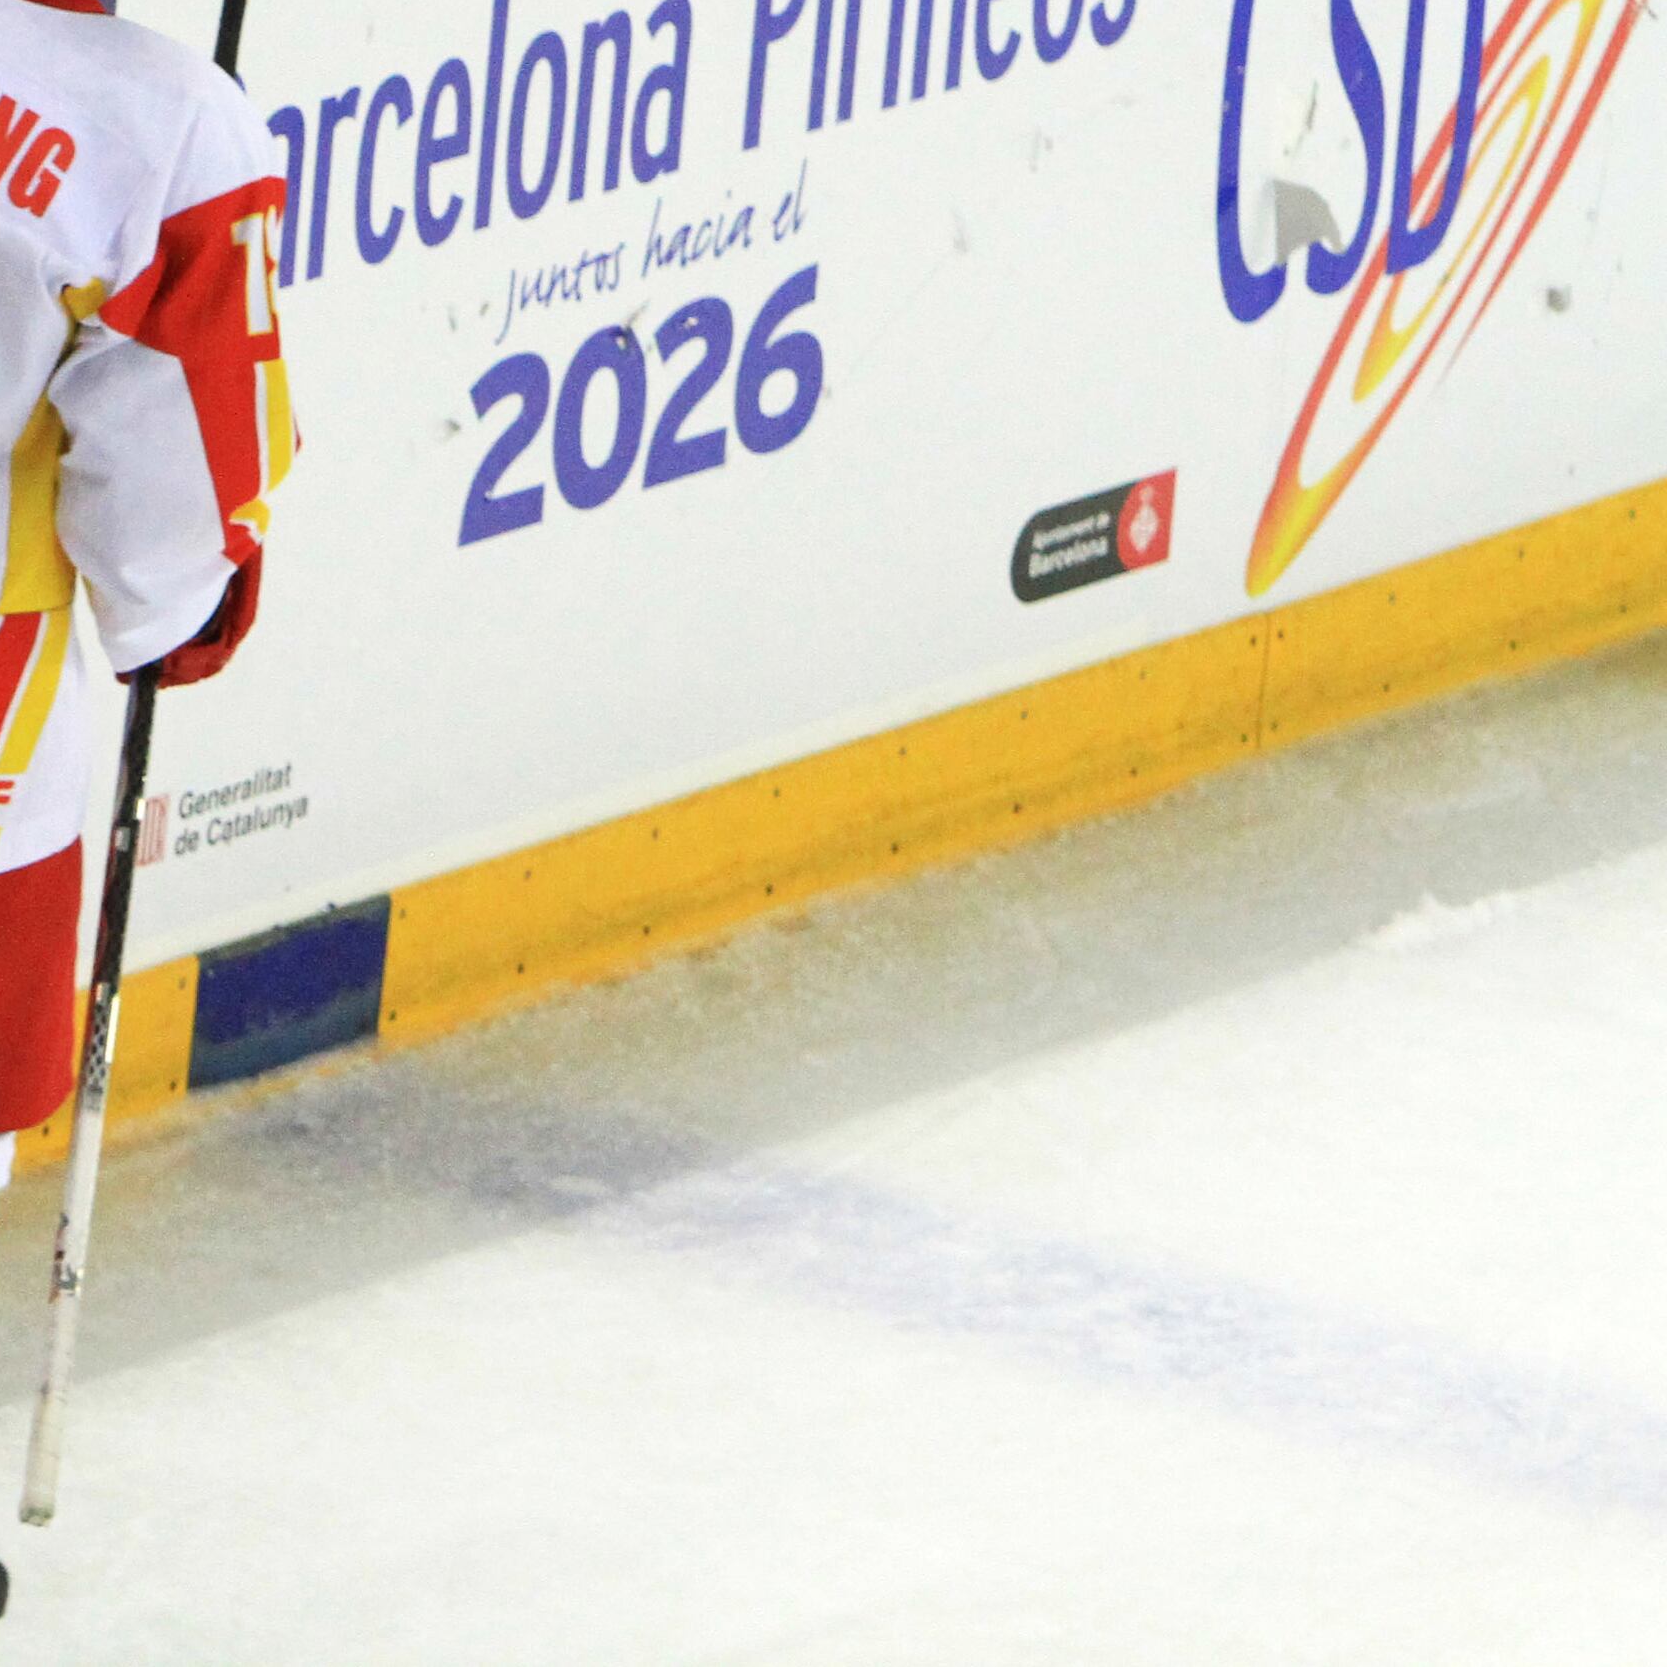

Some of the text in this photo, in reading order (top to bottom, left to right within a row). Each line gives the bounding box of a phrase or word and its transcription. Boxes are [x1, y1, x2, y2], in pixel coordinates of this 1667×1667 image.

[641, 193, 756, 277] hacia
[771, 158, 809, 236] el
[457, 262, 825, 548] 2026
[174, 794, 309, 856] de Catalunya
[178, 761, 293, 820] Generalitat
